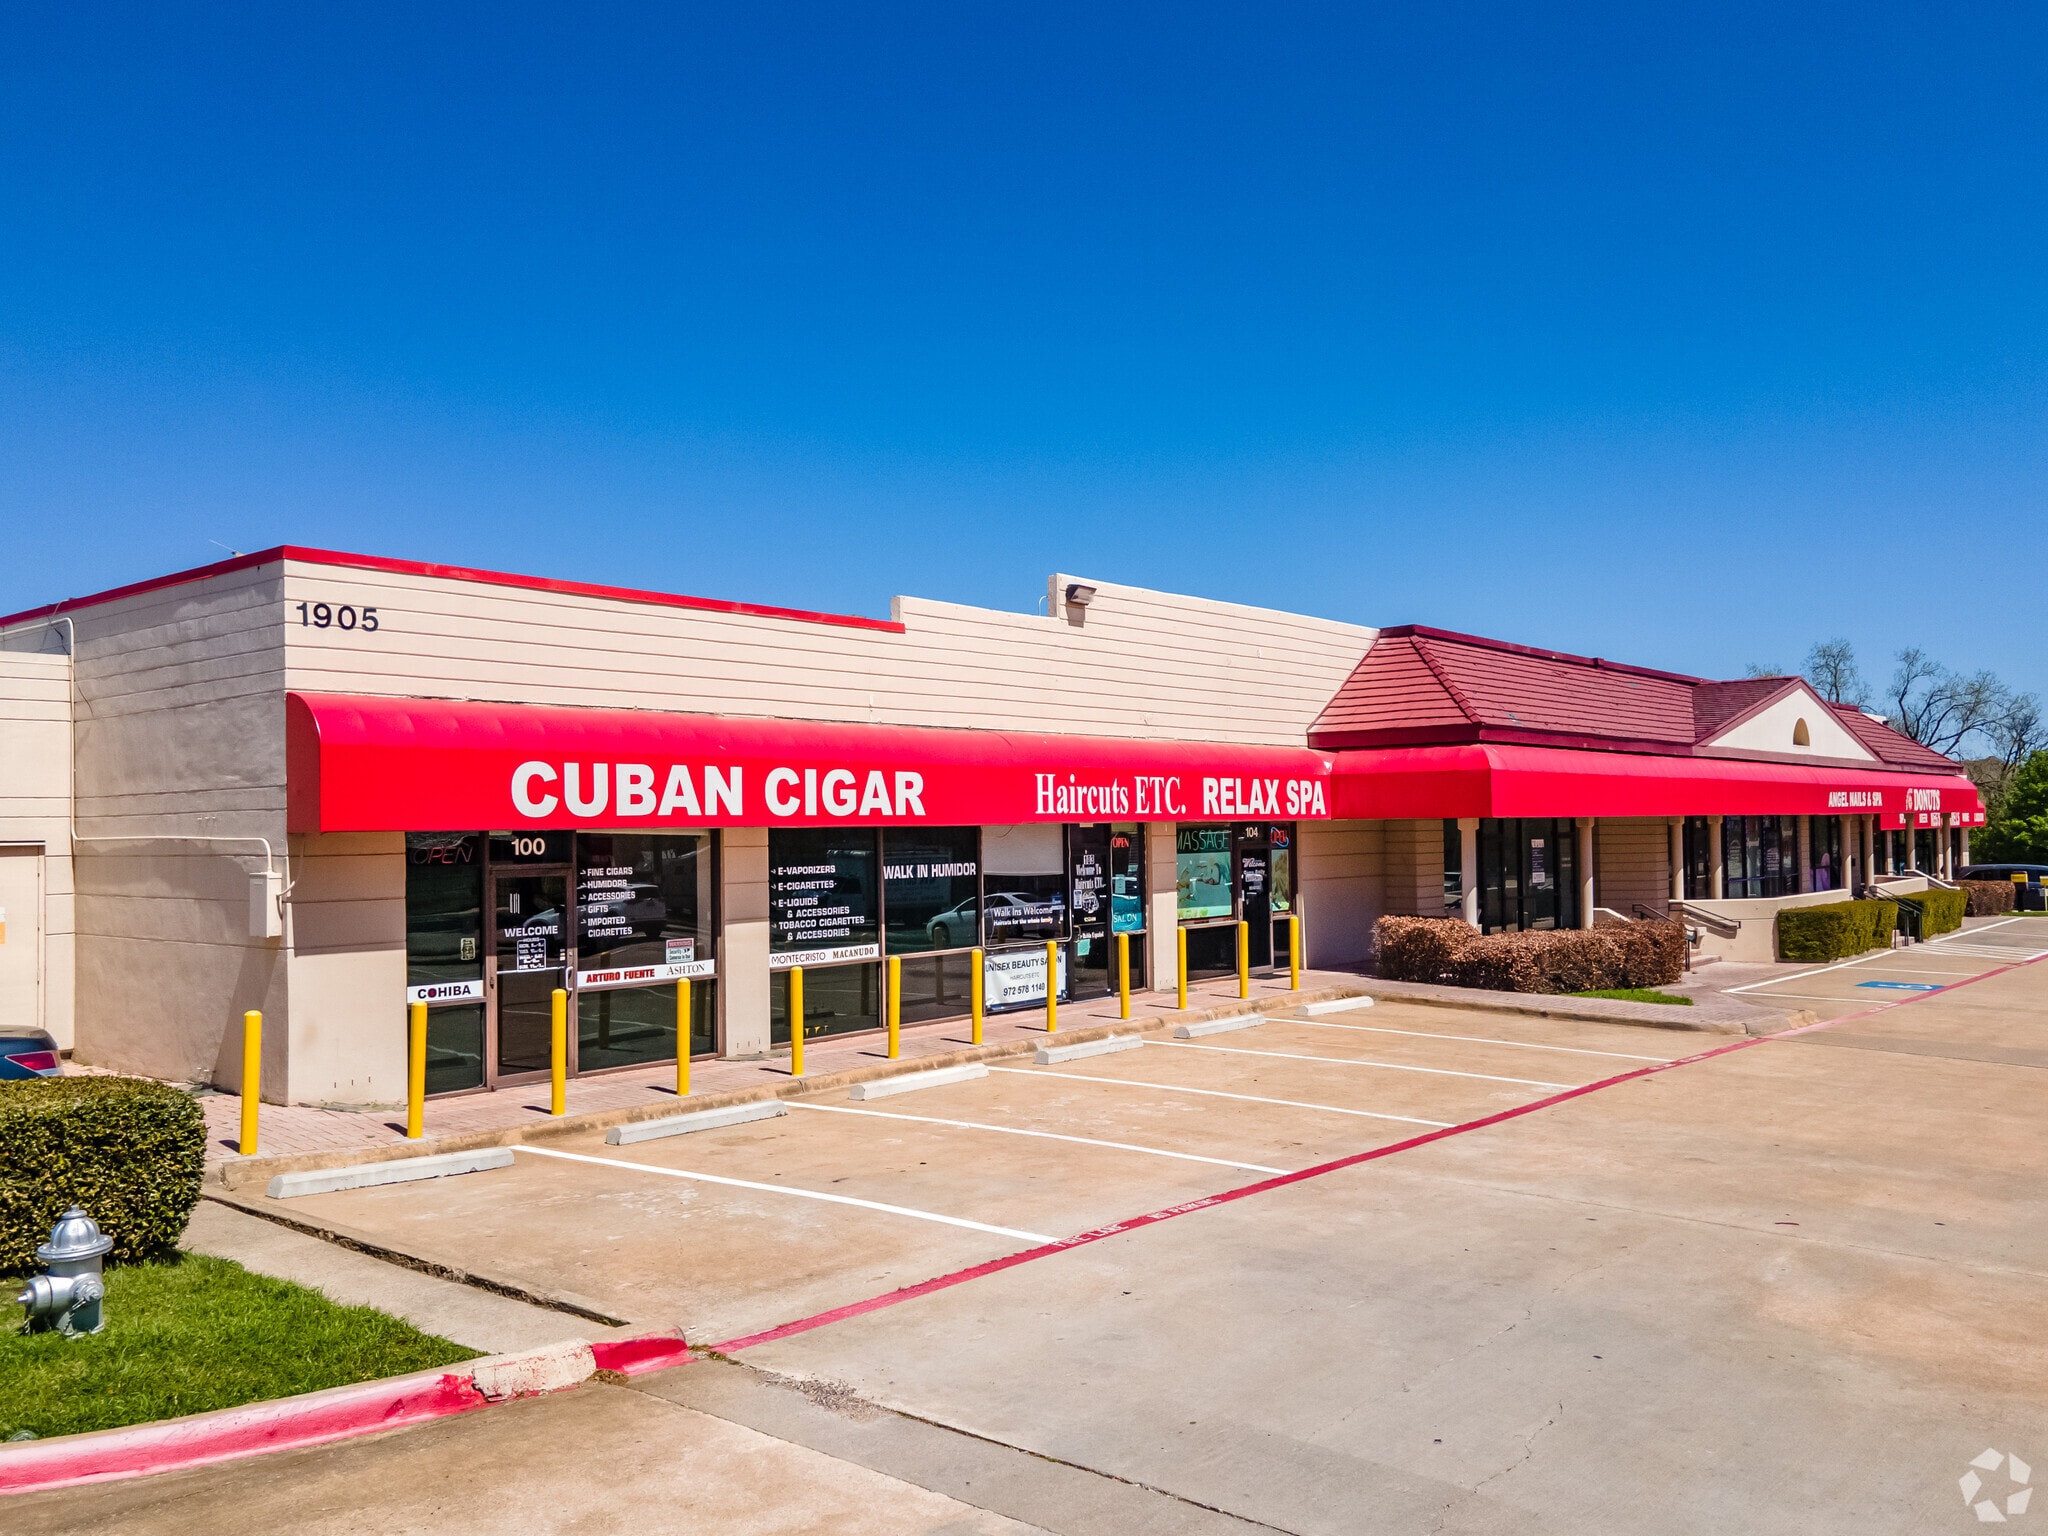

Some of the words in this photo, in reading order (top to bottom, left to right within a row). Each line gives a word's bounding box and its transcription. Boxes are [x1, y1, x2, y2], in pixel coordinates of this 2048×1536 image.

[296, 602, 379, 632] 1905
[511, 761, 743, 818] CUBAN
[765, 767, 926, 817] CIGAR
[1035, 773, 1128, 814] Haircuts
[1134, 776, 1186, 814] ETC.
[1203, 777, 1280, 815] RELAX
[1286, 780, 1326, 815] SPA
[1828, 791, 1848, 807] ANGEL
[1849, 791, 1866, 807] NAILS
[1867, 791, 1872, 806] &
[1872, 791, 1882, 806] SPA
[1913, 789, 1940, 811] DONUTS
[1245, 826, 1258, 838] 104
[511, 838, 546, 856] 100
[1111, 837, 1130, 848] OPEN
[411, 845, 473, 864] OPEN
[587, 868, 604, 877] FINE
[606, 867, 633, 876] CIGARS
[778, 865, 836, 875] E-VAPORIZERS
[883, 865, 914, 880] WALK
[917, 864, 928, 878] IN
[931, 862, 976, 878] HUMIDOR
[587, 880, 627, 889] HUMIDORS
[778, 880, 834, 891] E-CIGARETTES
[588, 891, 636, 901] ACCESSORIES
[778, 897, 818, 908] E-LIQUIDS
[588, 905, 608, 914] GIFTS
[787, 910, 793, 918] &
[796, 906, 850, 918] ACCESSORIES
[993, 907, 1011, 917] Walk
[1012, 906, 1022, 916] Ins
[1023, 905, 1053, 915] Welcome
[588, 916, 625, 927] IMPORTED
[779, 919, 817, 930] TOBACCO
[819, 916, 865, 927] CIGARETTES
[1113, 913, 1137, 923] SALON
[504, 925, 559, 938] WELCOME
[588, 927, 632, 938] CIGARETTES
[787, 932, 793, 941] &
[796, 928, 850, 940] ACCESSORIES
[771, 951, 826, 965] MONTECRISTO
[832, 946, 874, 959] MACANUDO
[666, 963, 706, 976] ASHTON
[985, 961, 1011, 973] UNISEX
[1012, 958, 1039, 970] BEAUTY
[1040, 954, 1062, 966] SAN
[586, 971, 621, 984] ARTURO
[623, 968, 656, 980] FUENTE
[417, 984, 472, 1000] COHIBA
[1003, 986, 1016, 997] 972
[1017, 984, 1030, 995] 578
[1031, 982, 1046, 993] 1140
[1052, 1234, 1092, 1248] FIRE
[1091, 1223, 1129, 1238] LANE
